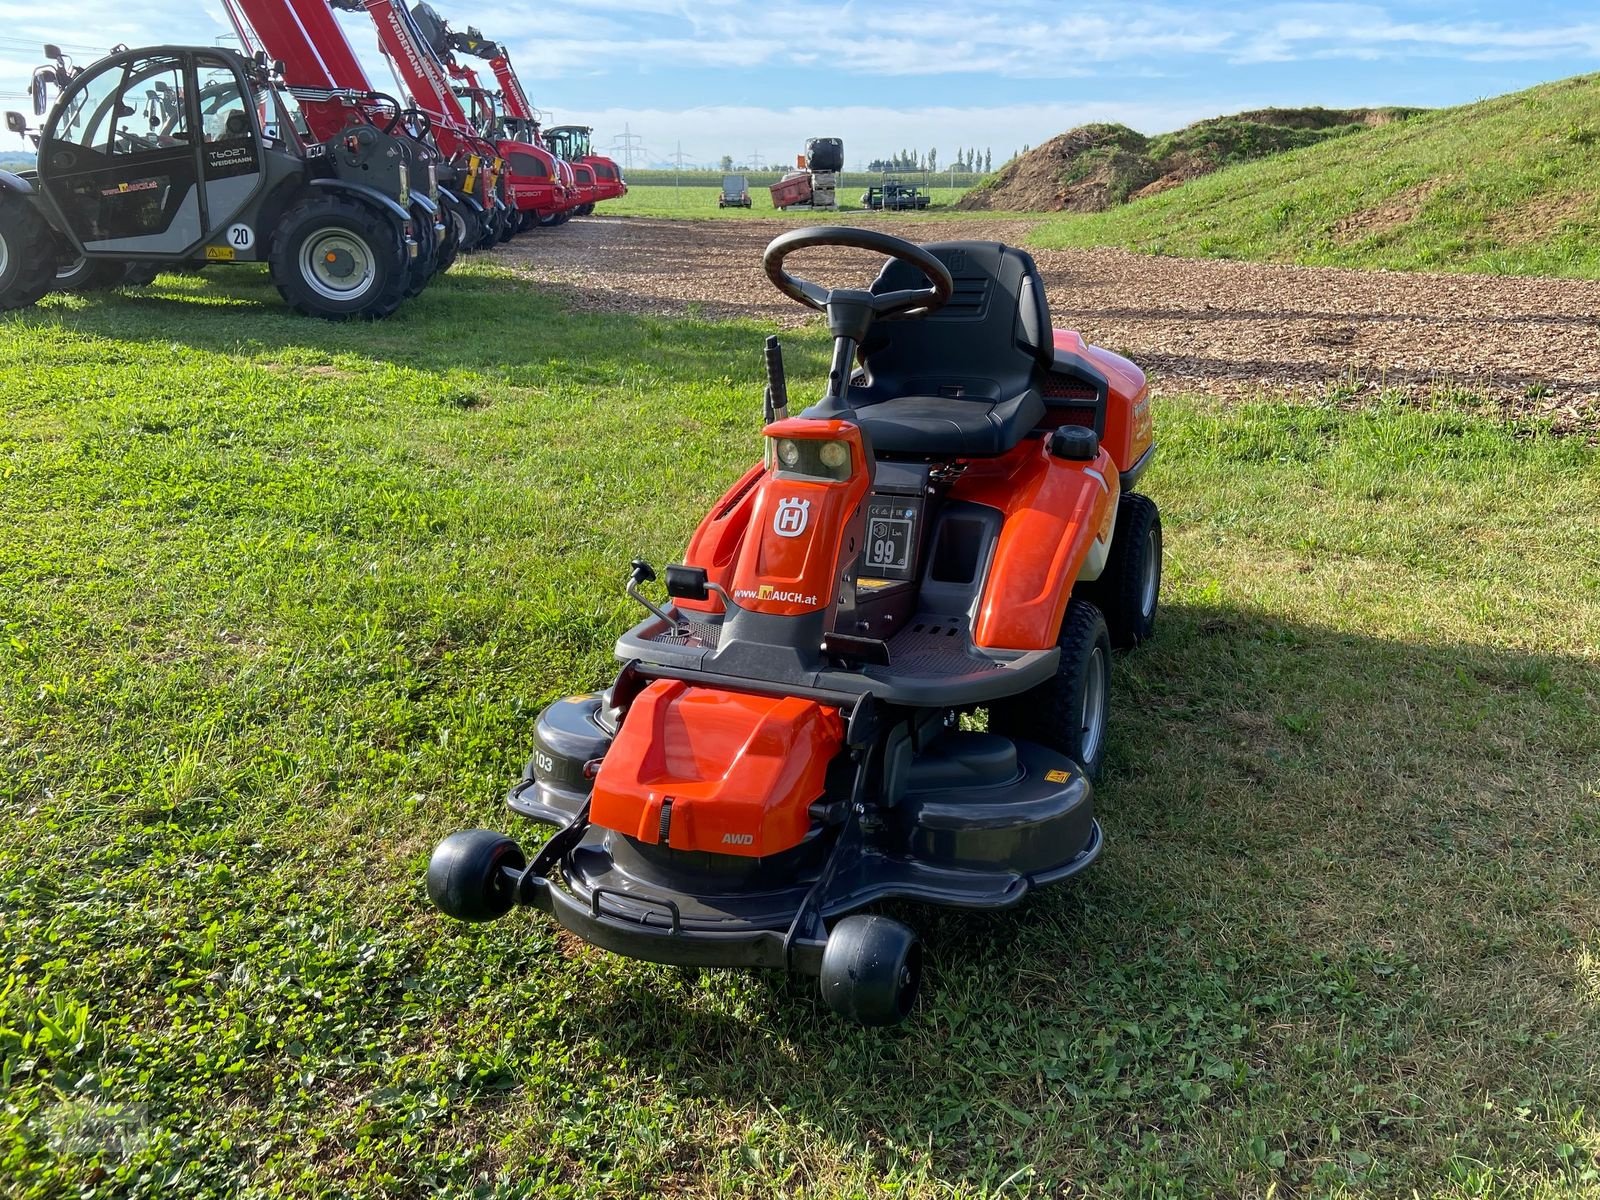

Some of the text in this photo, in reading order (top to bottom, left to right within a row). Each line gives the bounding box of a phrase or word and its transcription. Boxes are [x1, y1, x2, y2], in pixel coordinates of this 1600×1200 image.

[387, 11, 425, 79] WEIDEMANN
[209, 148, 247, 159] T6027
[210, 156, 253, 167] WEIDEMANN
[233, 228, 249, 245] 20
[873, 540, 895, 564] 99
[734, 588, 817, 605] www.MAUCH.at
[535, 750, 553, 772] 103
[720, 833, 754, 845] AWD
